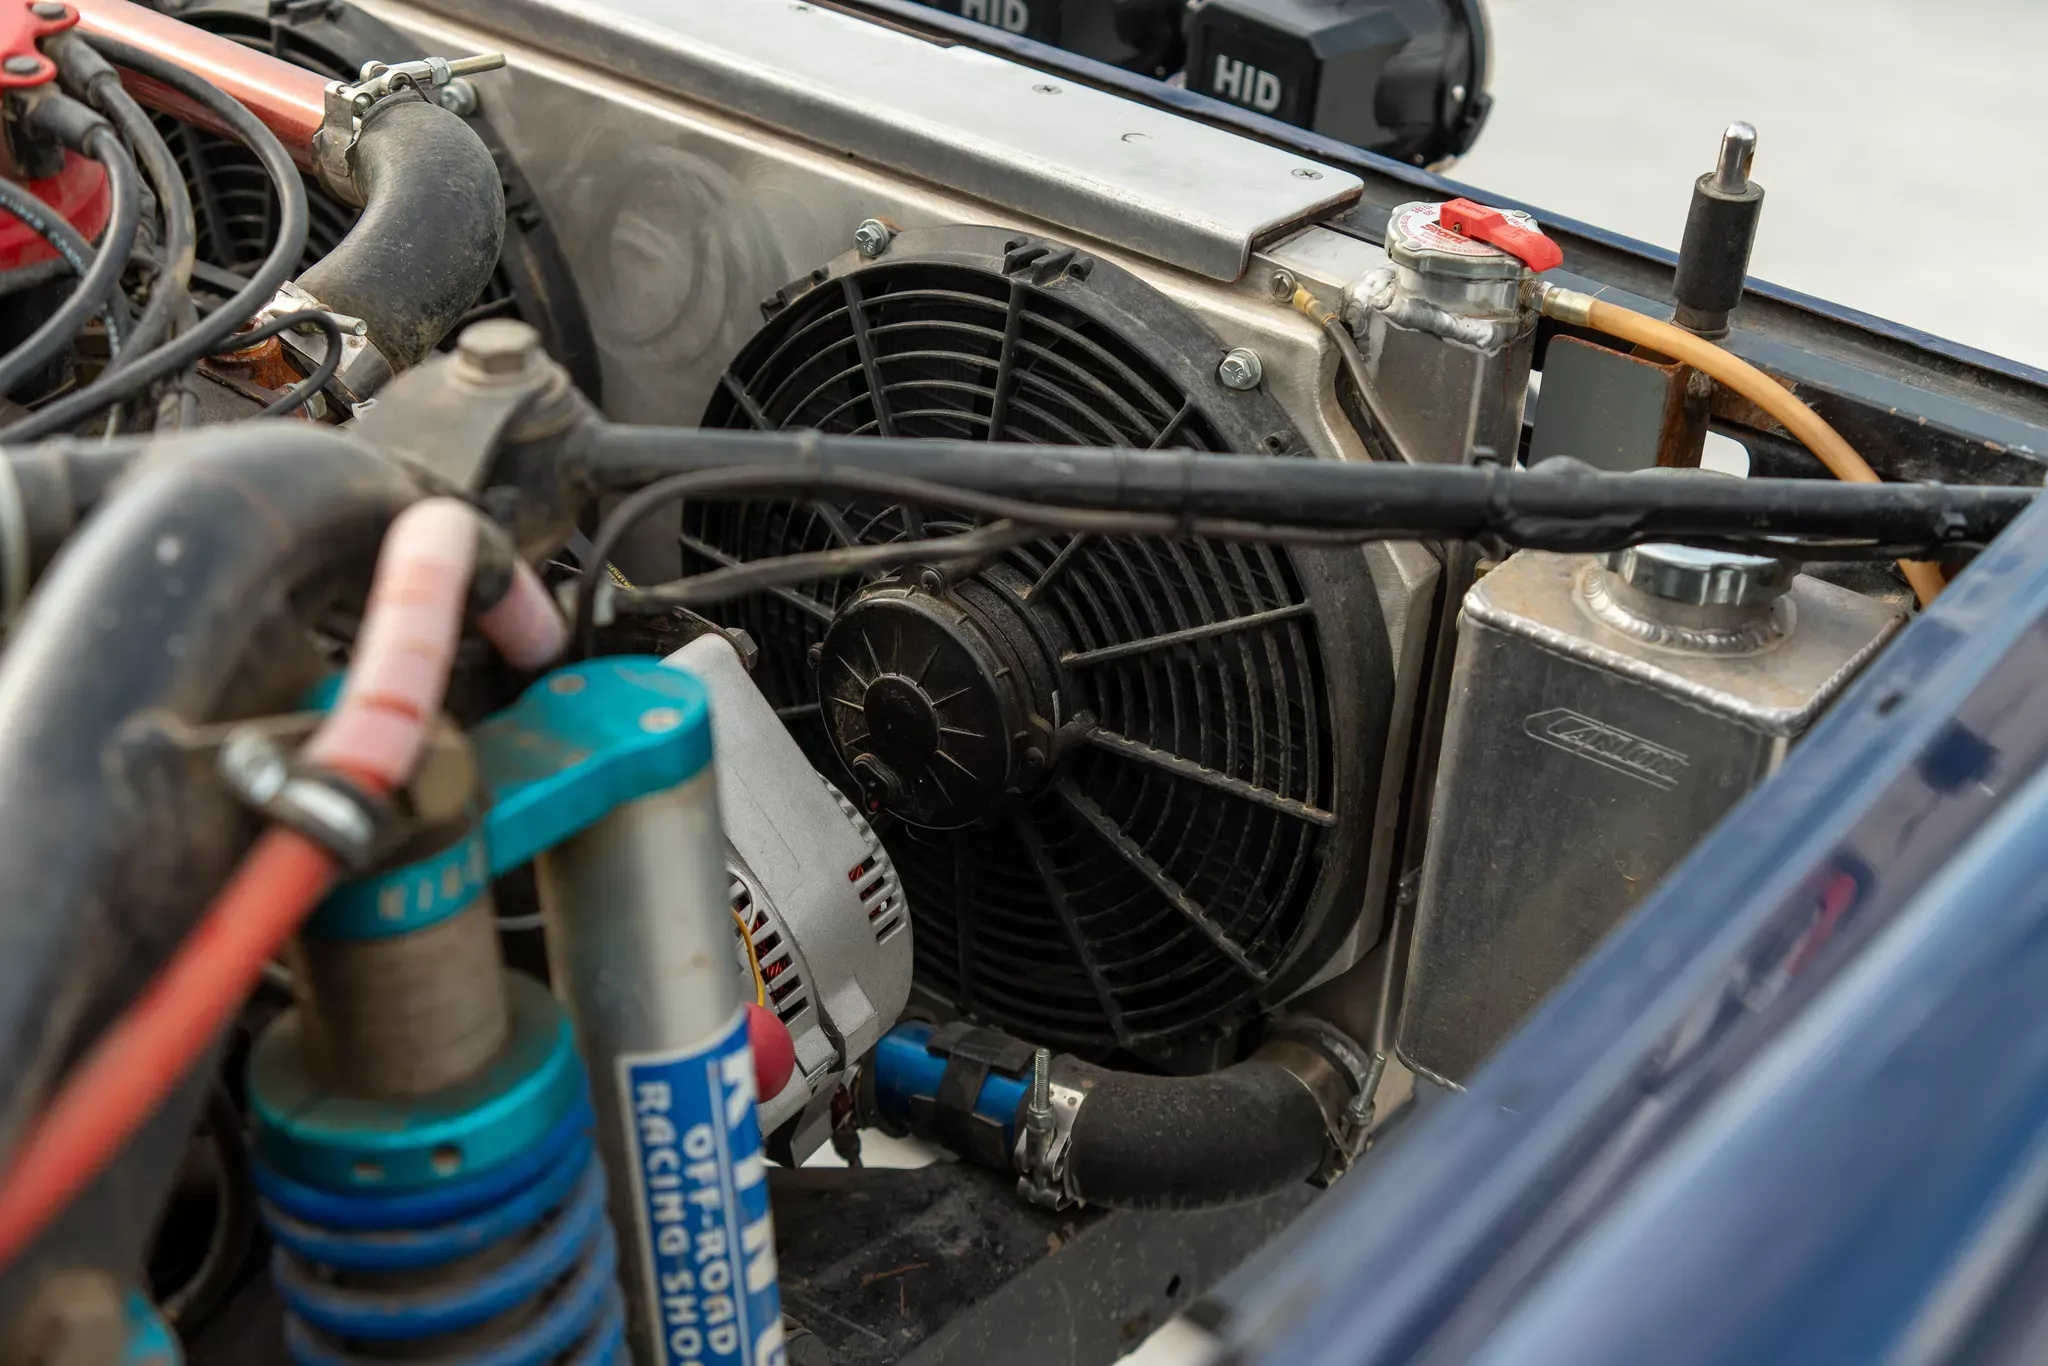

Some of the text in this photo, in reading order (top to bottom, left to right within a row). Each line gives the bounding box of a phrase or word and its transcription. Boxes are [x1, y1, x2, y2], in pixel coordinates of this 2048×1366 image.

[1213, 53, 1281, 113] HID
[636, 1080, 705, 1366] RACING SHO
[682, 1121, 740, 1356] OFF-ROAD
